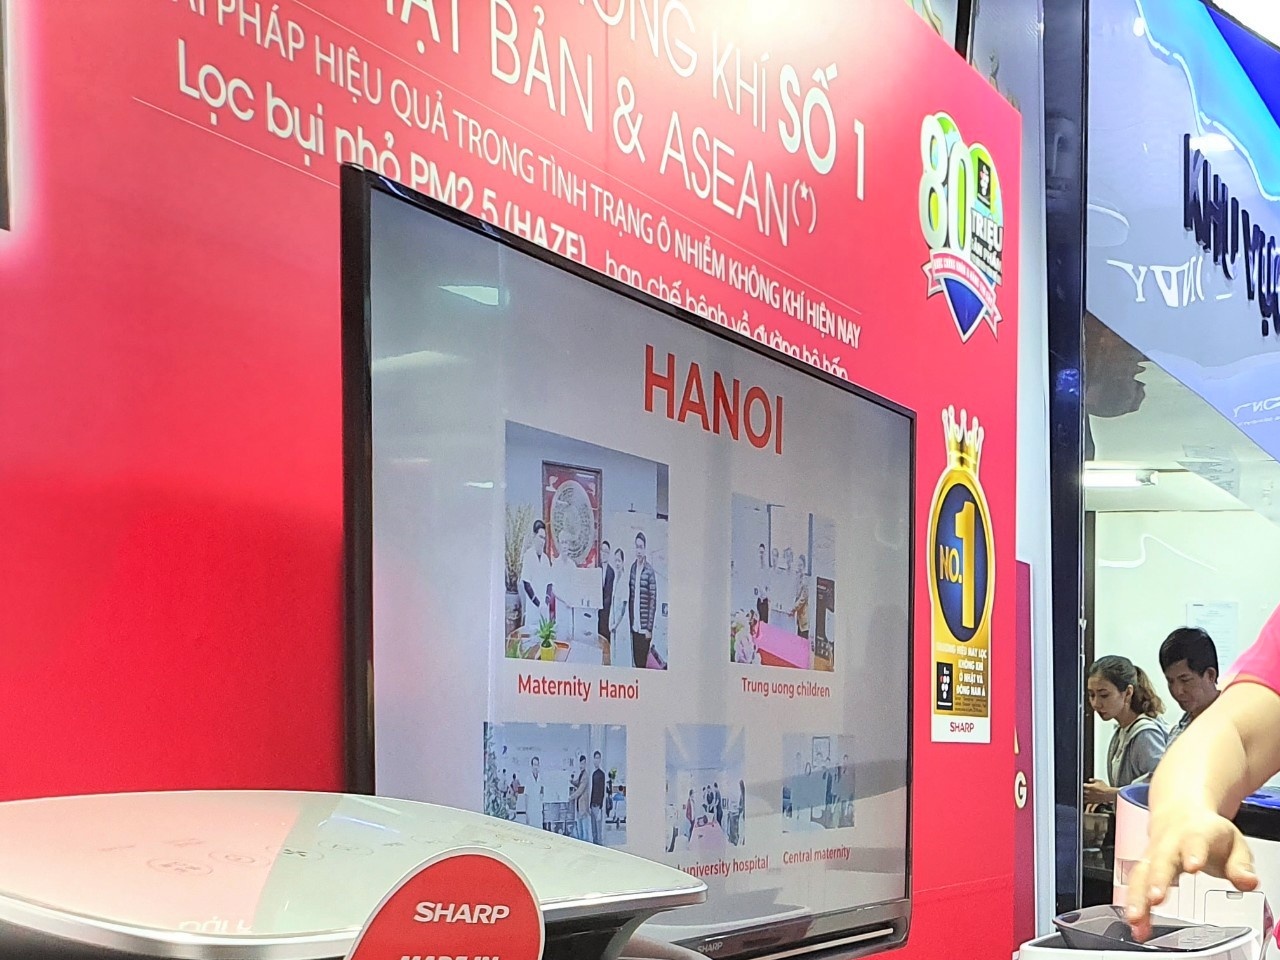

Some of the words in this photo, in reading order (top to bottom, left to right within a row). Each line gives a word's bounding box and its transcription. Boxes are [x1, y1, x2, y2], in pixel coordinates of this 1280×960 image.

[490, 0, 592, 133] BẢN
[613, 76, 646, 164] &
[711, 23, 770, 134] KHÍ
[777, 62, 838, 175] SỐ
[853, 117, 866, 202] 1
[177, 38, 255, 126] Lọc
[266, 81, 325, 166] bụi
[410, 152, 499, 226] PM25
[314, 34, 382, 104] HIỆU
[390, 79, 449, 141] QUẢ
[453, 109, 535, 184] TRONG
[538, 154, 588, 212] TÌNH
[591, 183, 654, 238] TRẠNG
[656, 215, 672, 253] Ô
[674, 229, 726, 282] NHIỄM
[728, 258, 780, 309] KHÔNG
[782, 287, 805, 321] KHÍ
[806, 298, 835, 338] HIỆN
[837, 317, 861, 349] NAY
[1184, 133, 1240, 280] KHU
[644, 344, 783, 455] HANOI
[518, 673, 592, 702] Maternity
[598, 678, 640, 700] Hanoi
[741, 677, 770, 699] Trung
[772, 682, 796, 699] uong
[796, 681, 831, 699] children
[949, 721, 975, 733] SHARP
[732, 855, 769, 878] hospital
[782, 848, 812, 866] Central
[813, 844, 851, 864] maternity
[413, 901, 510, 924] SHARP
